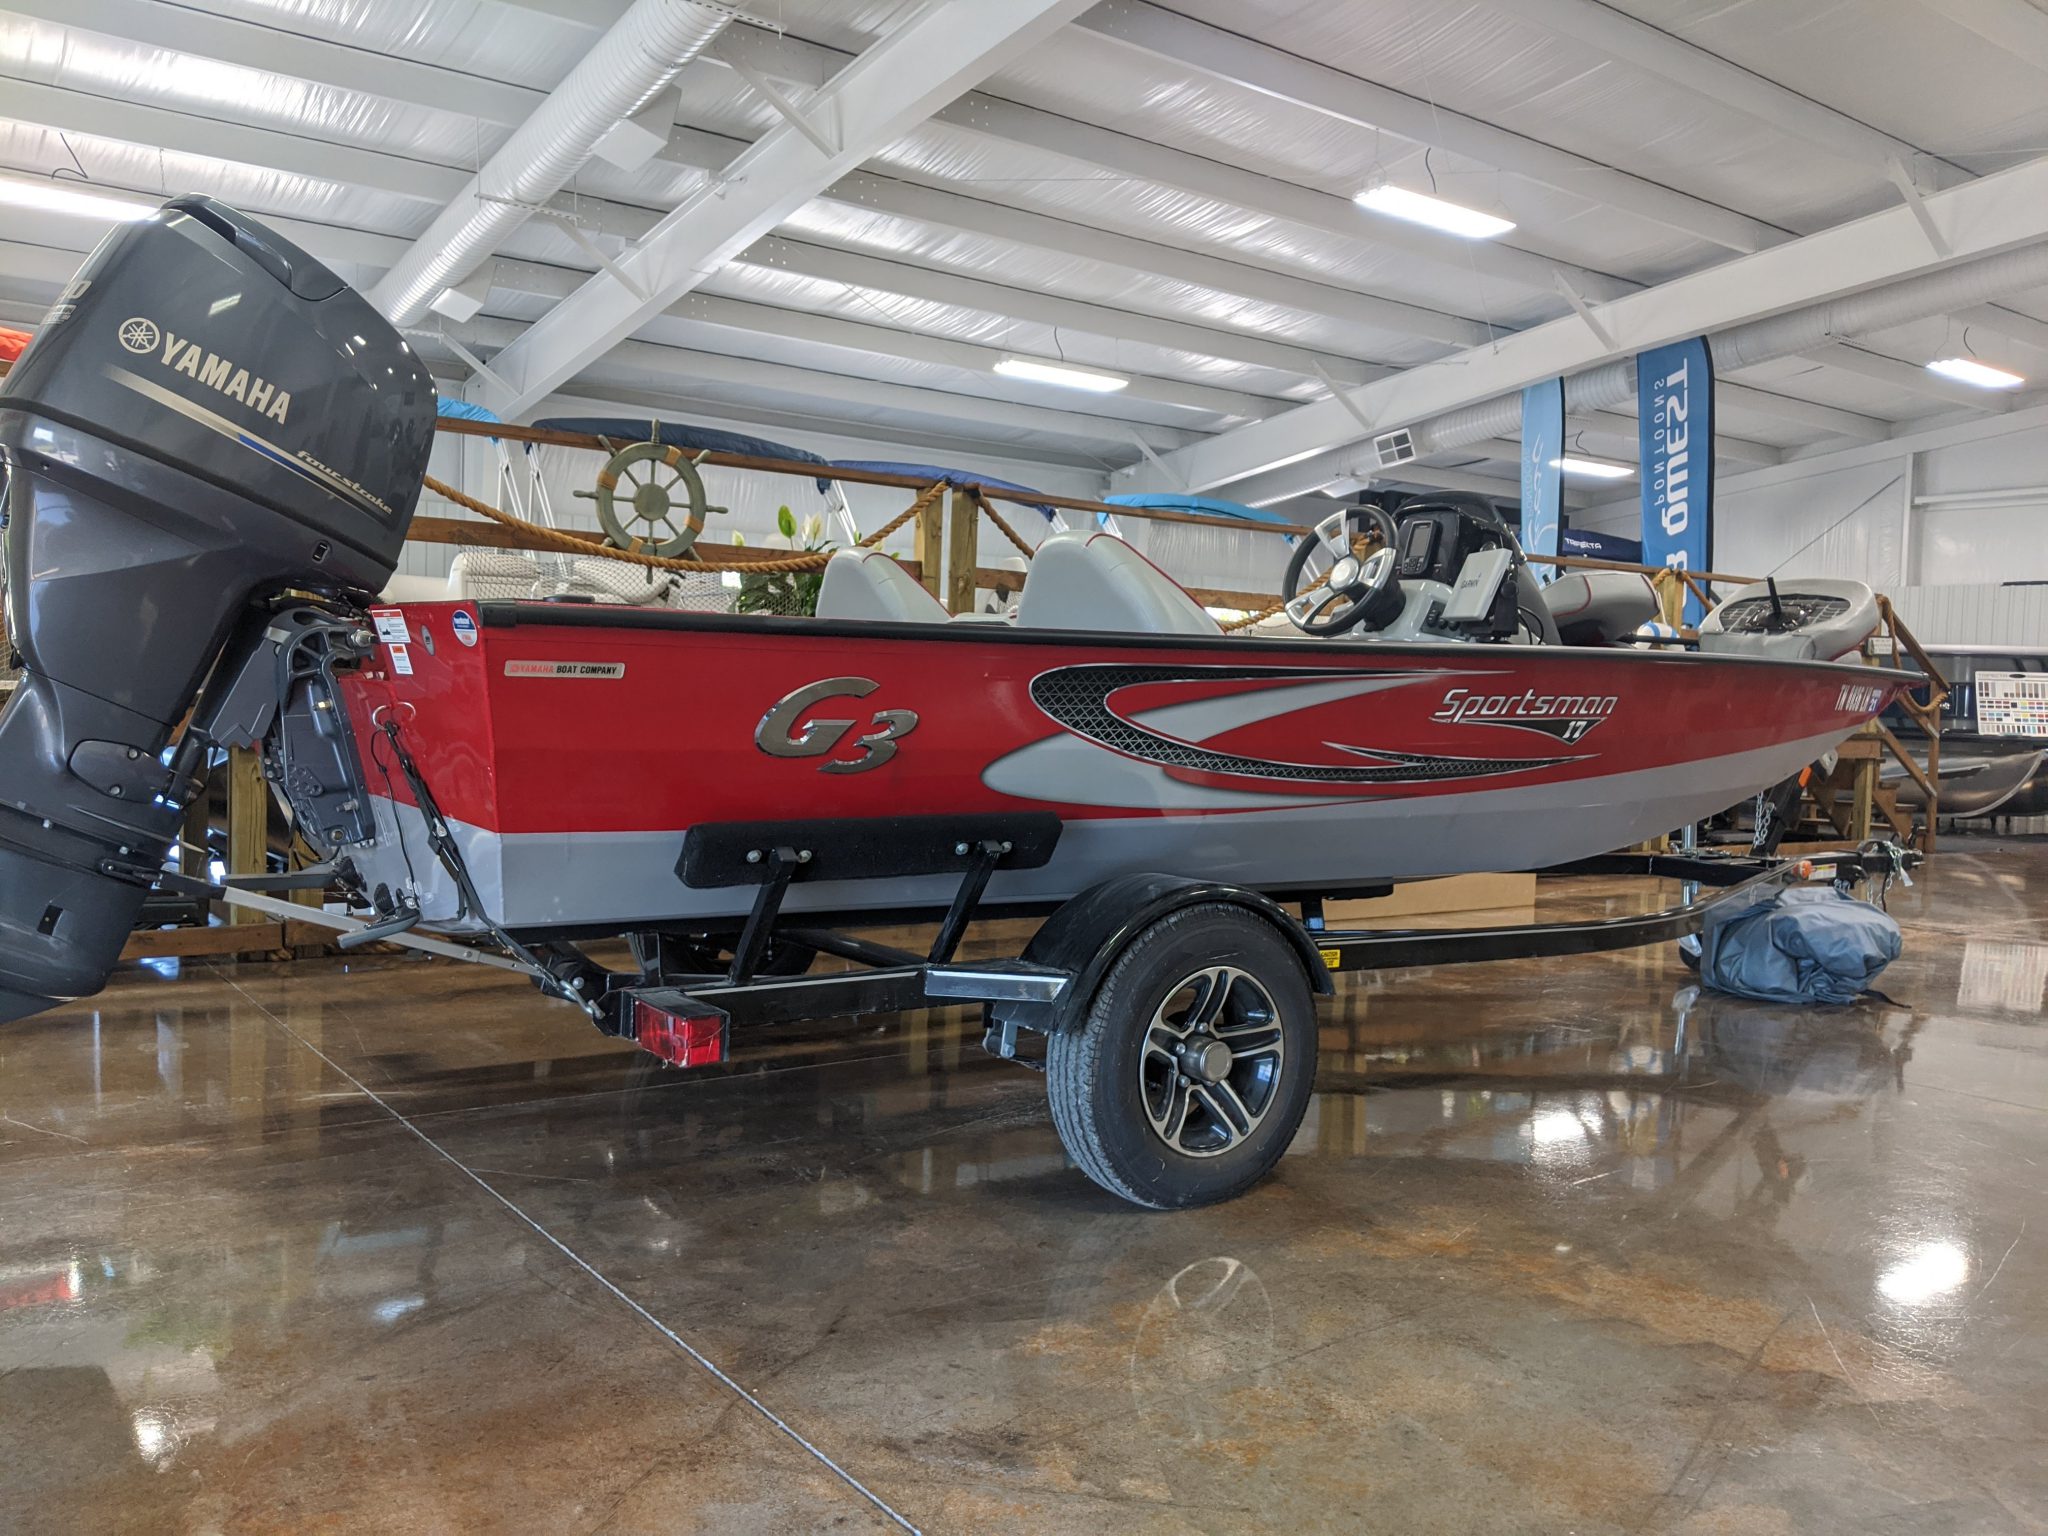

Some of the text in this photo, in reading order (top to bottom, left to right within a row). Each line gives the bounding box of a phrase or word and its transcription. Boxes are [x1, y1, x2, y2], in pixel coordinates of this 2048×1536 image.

[160, 331, 291, 425] YAMAHA
[556, 665, 577, 674] BOAT
[579, 666, 617, 675] COMPANY
[1434, 688, 1618, 723] Sportsman
[754, 676, 918, 774] G3
[1563, 720, 1587, 739] 17
